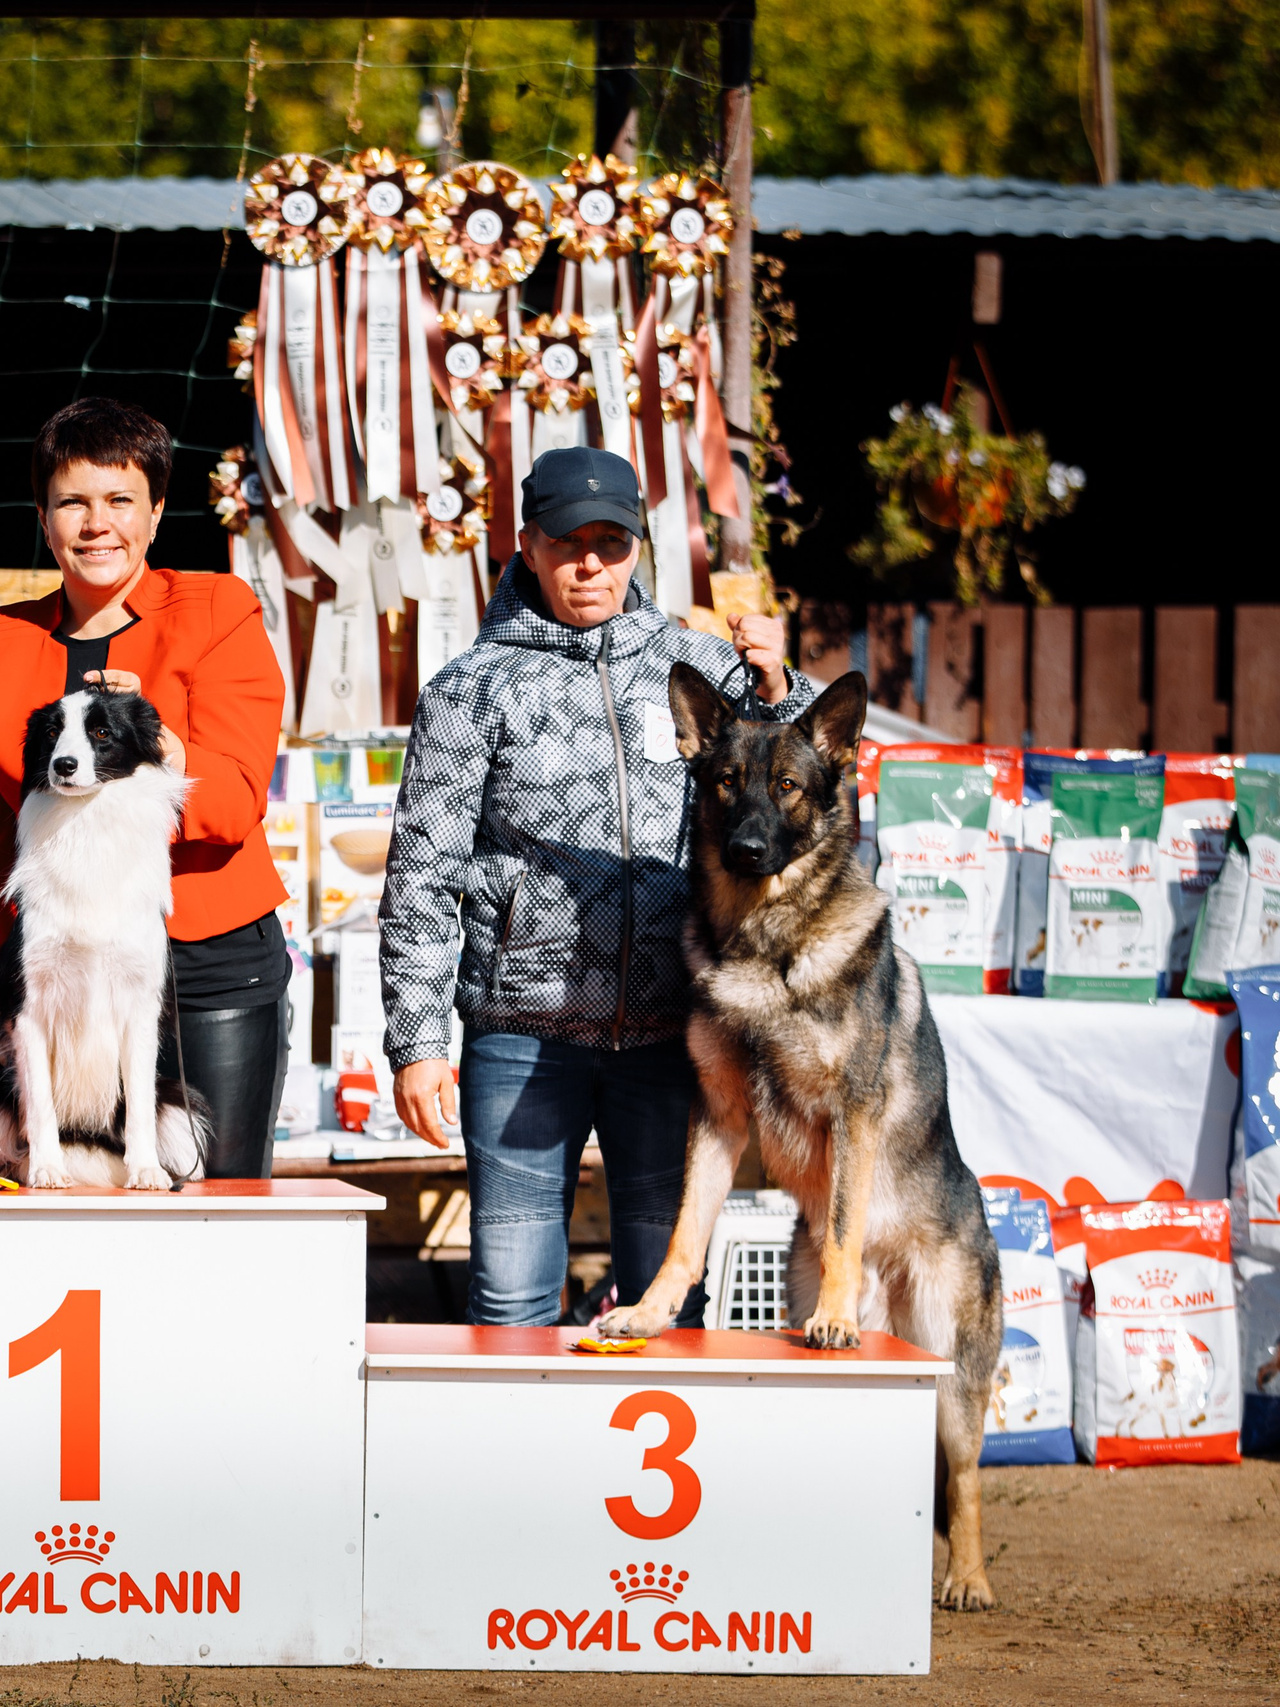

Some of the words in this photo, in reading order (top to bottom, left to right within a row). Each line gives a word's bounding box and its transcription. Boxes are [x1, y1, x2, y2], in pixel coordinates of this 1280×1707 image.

[1072, 890, 1110, 904] MINI
[1003, 1285, 1042, 1304] ANIN
[1110, 1295, 1155, 1309] ROYAL
[1160, 1289, 1215, 1308] CANIN
[8, 1289, 101, 1501] 1
[604, 1389, 702, 1540] 3
[80, 1570, 241, 1614] CANIN
[487, 1608, 641, 1652] ROYAL
[653, 1610, 812, 1655] CANIN
